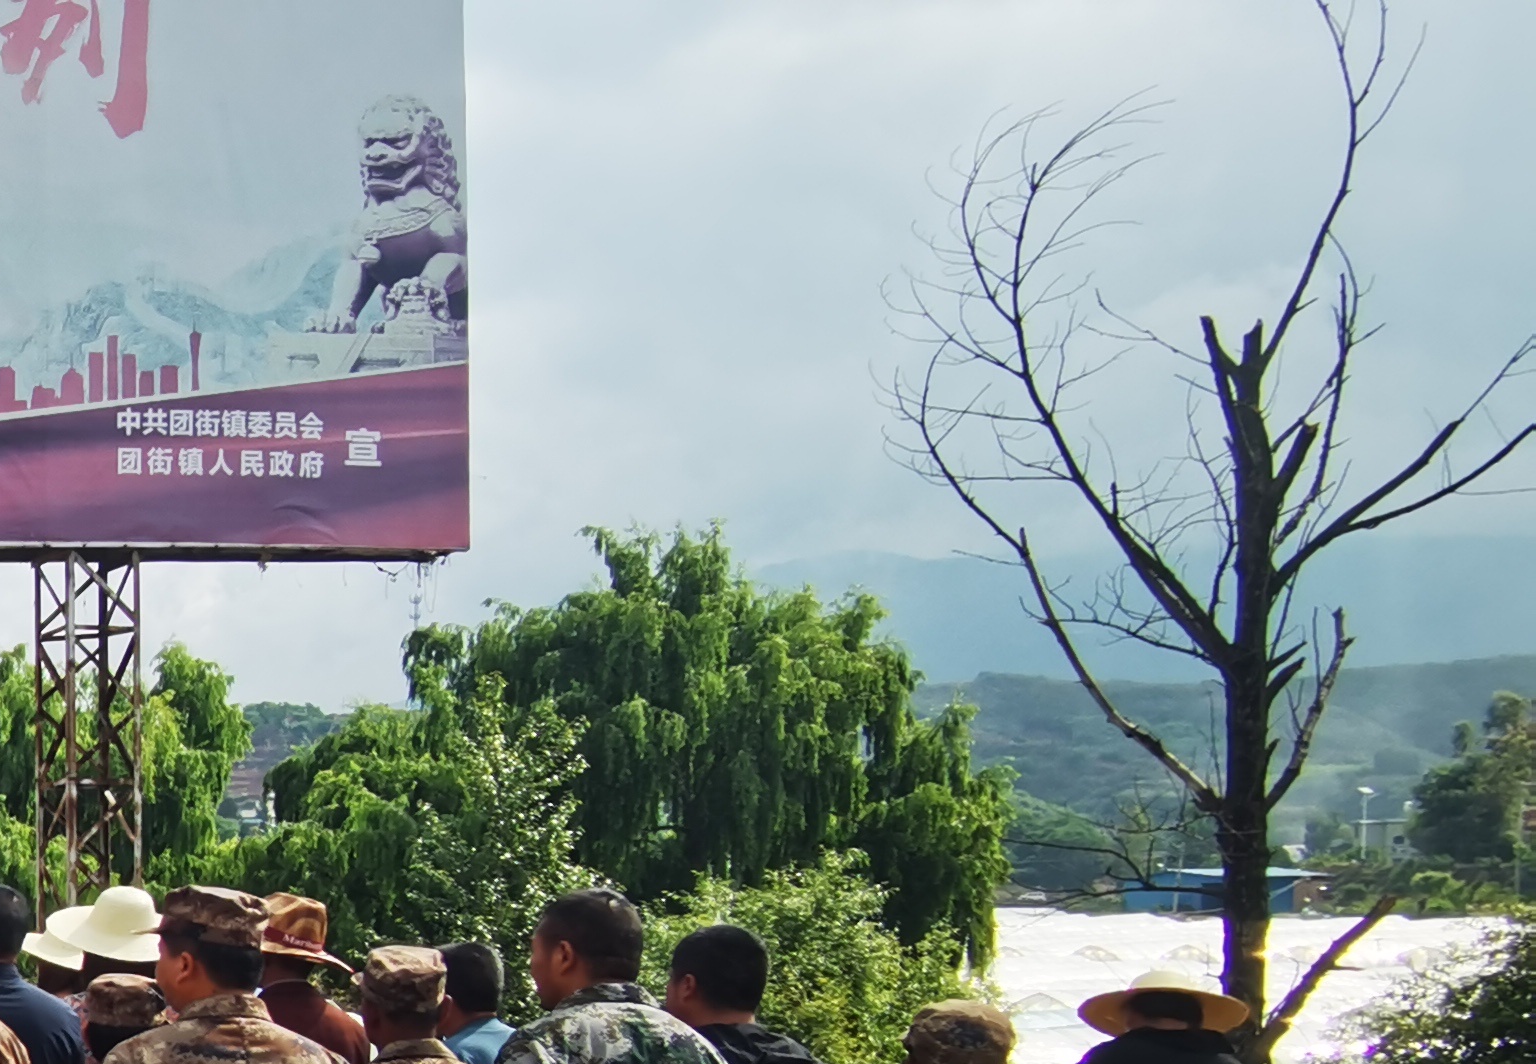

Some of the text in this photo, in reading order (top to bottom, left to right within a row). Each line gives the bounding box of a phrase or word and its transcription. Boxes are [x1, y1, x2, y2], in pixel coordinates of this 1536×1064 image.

[116, 407, 324, 440] 中共团街镇委员会
[117, 447, 324, 478] 团街镇人民政府
[344, 427, 382, 467] 宣
